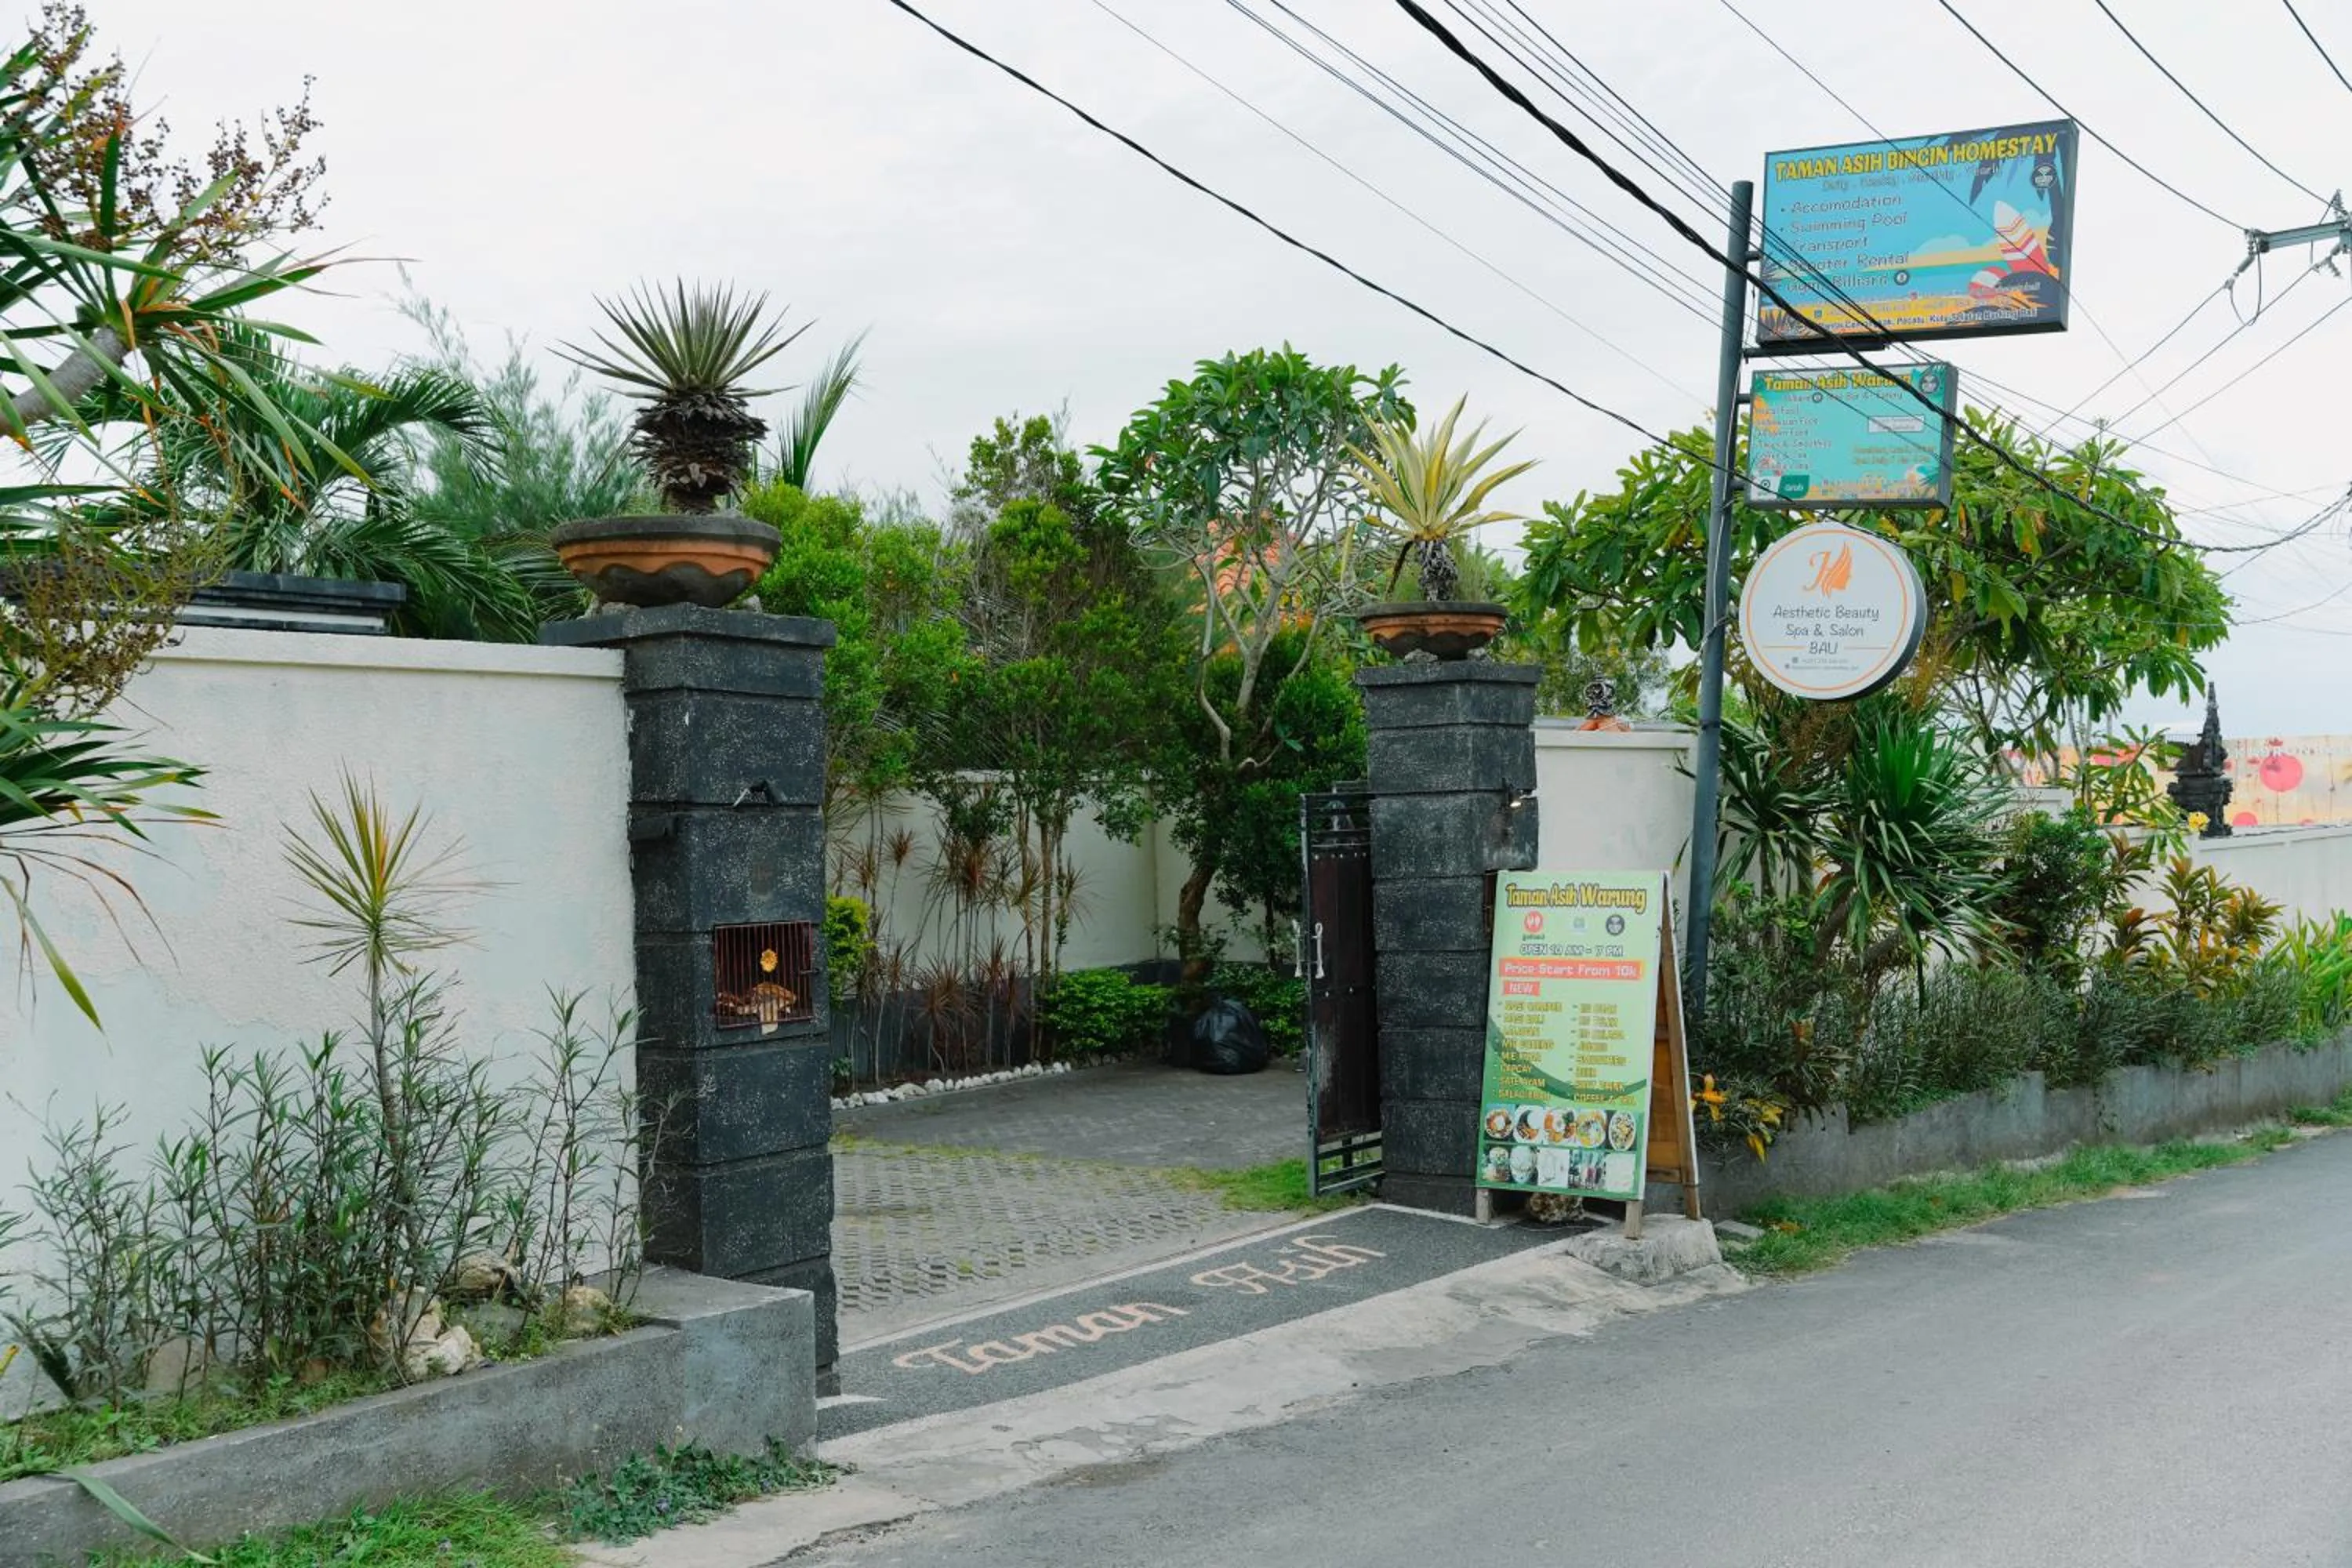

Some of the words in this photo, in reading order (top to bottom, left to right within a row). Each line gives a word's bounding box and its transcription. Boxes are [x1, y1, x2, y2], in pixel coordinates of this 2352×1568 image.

[1775, 157, 1838, 182] TAMAN
[1841, 152, 1882, 175] ASIH
[1887, 146, 1947, 170] BINGIN
[1952, 132, 2058, 163] HOMESTAY
[1791, 194, 1902, 213] Accomodation
[1872, 212, 1907, 227] Pool
[1857, 252, 1910, 268] Rental
[1765, 375, 1813, 390] Taman
[1817, 372, 1847, 389] Asih
[1773, 604, 1831, 619] Aesthetic
[1835, 605, 1880, 621] Beauty
[1786, 624, 1809, 639] Spa
[1813, 624, 1825, 637] &
[1829, 624, 1864, 637] Salon
[1808, 641, 1838, 655] BALI
[1505, 883, 1548, 908] Taman
[1548, 883, 1578, 908] Asih
[1580, 882, 1647, 914] Warung
[1520, 943, 1548, 956] OPEN
[1564, 945, 1584, 956] AM
[1605, 945, 1624, 957] PM
[1504, 962, 1536, 975] Price
[1538, 963, 1573, 975] Start
[1577, 964, 1610, 976] From
[1616, 964, 1636, 977] 10k
[1509, 982, 1534, 994] NEW
[893, 1300, 1191, 1375] Taman
[1189, 1234, 1388, 1295] Asih
